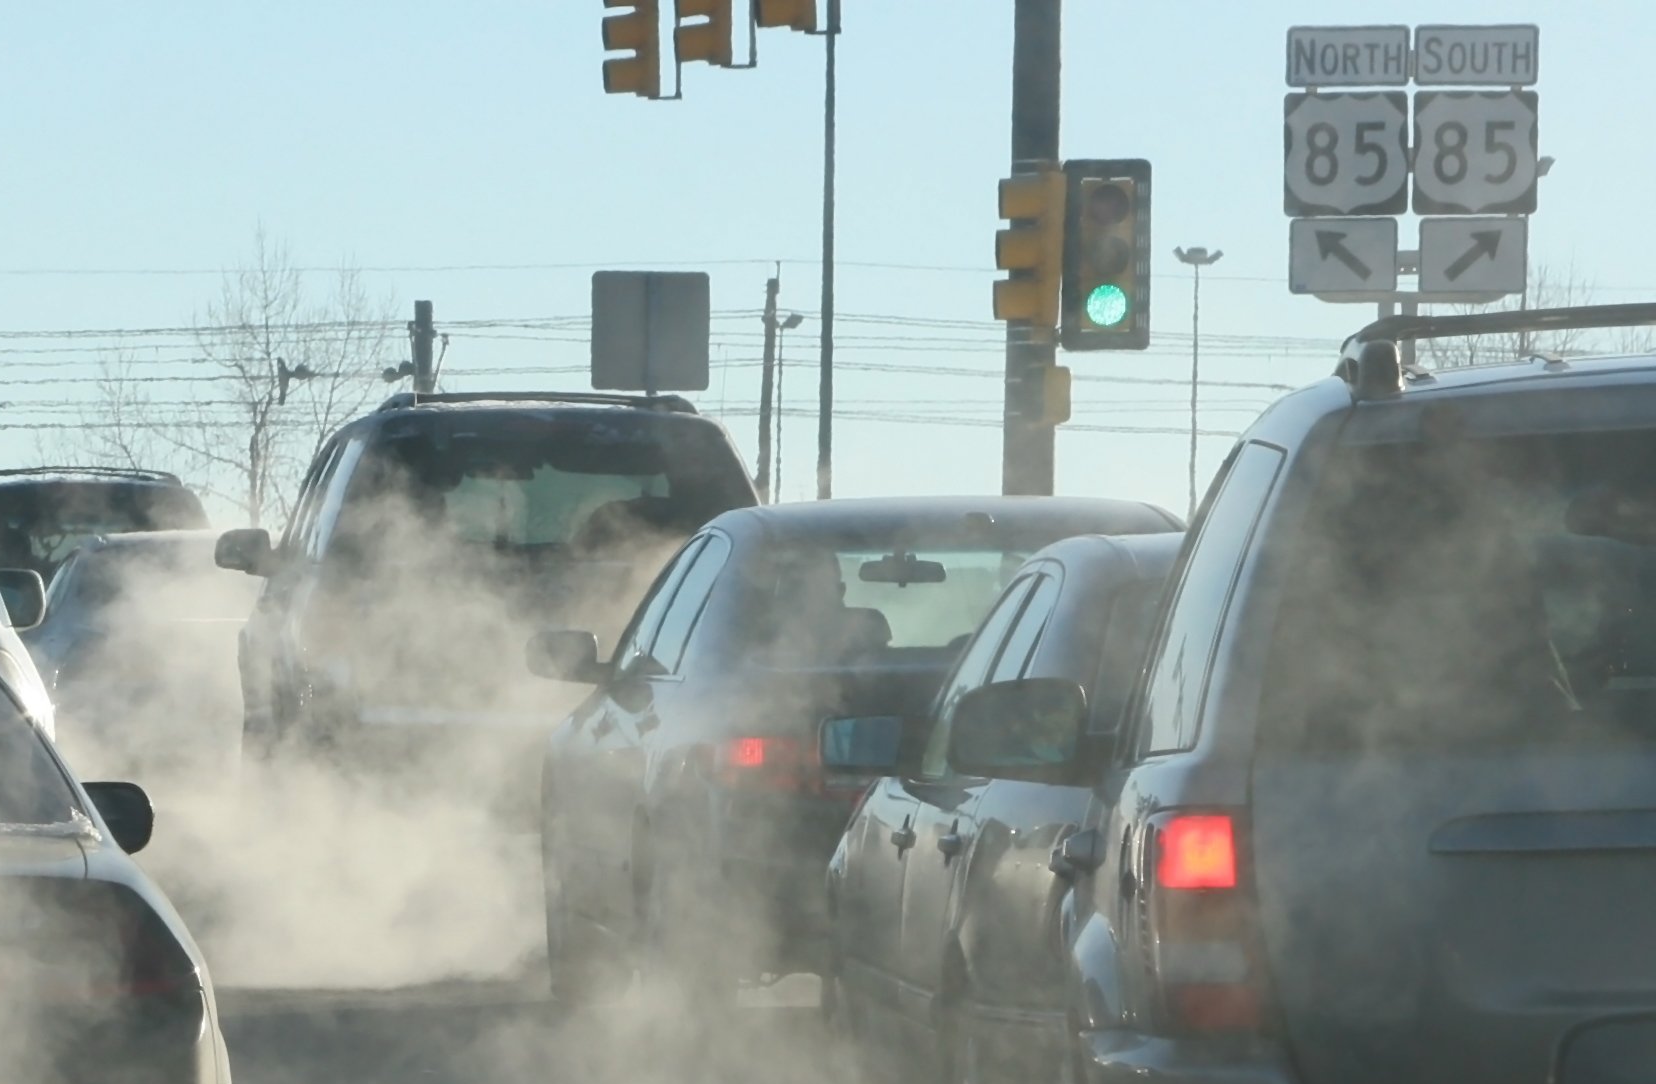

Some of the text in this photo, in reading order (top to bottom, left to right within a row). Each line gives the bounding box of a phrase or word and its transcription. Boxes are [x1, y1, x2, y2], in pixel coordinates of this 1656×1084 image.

[1293, 38, 1401, 76] NORTH
[1422, 36, 1531, 75] SOUTH
[1304, 121, 1388, 186] 85
[1433, 121, 1517, 186] 85
